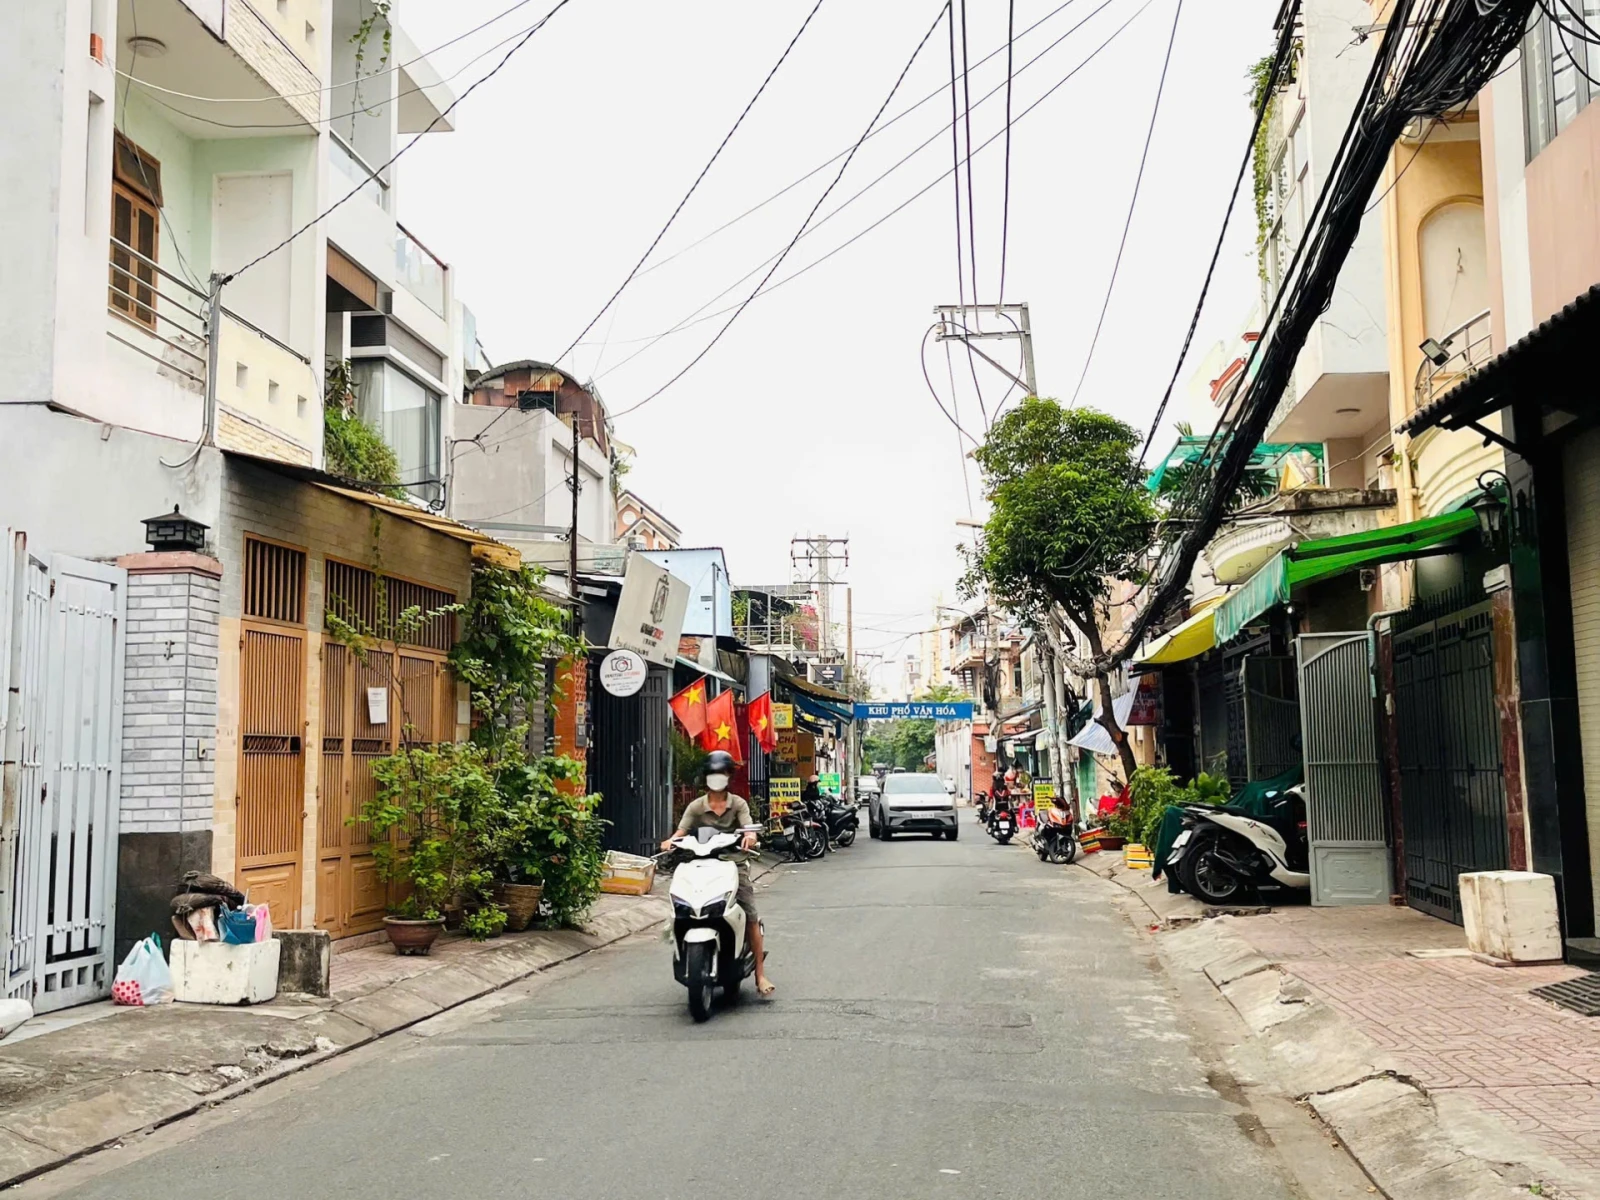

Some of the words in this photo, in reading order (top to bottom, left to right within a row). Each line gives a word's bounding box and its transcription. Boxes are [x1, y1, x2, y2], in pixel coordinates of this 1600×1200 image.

[868, 706, 889, 715] KHU
[891, 703, 911, 715] PHỐ
[935, 704, 957, 715] HÓA
